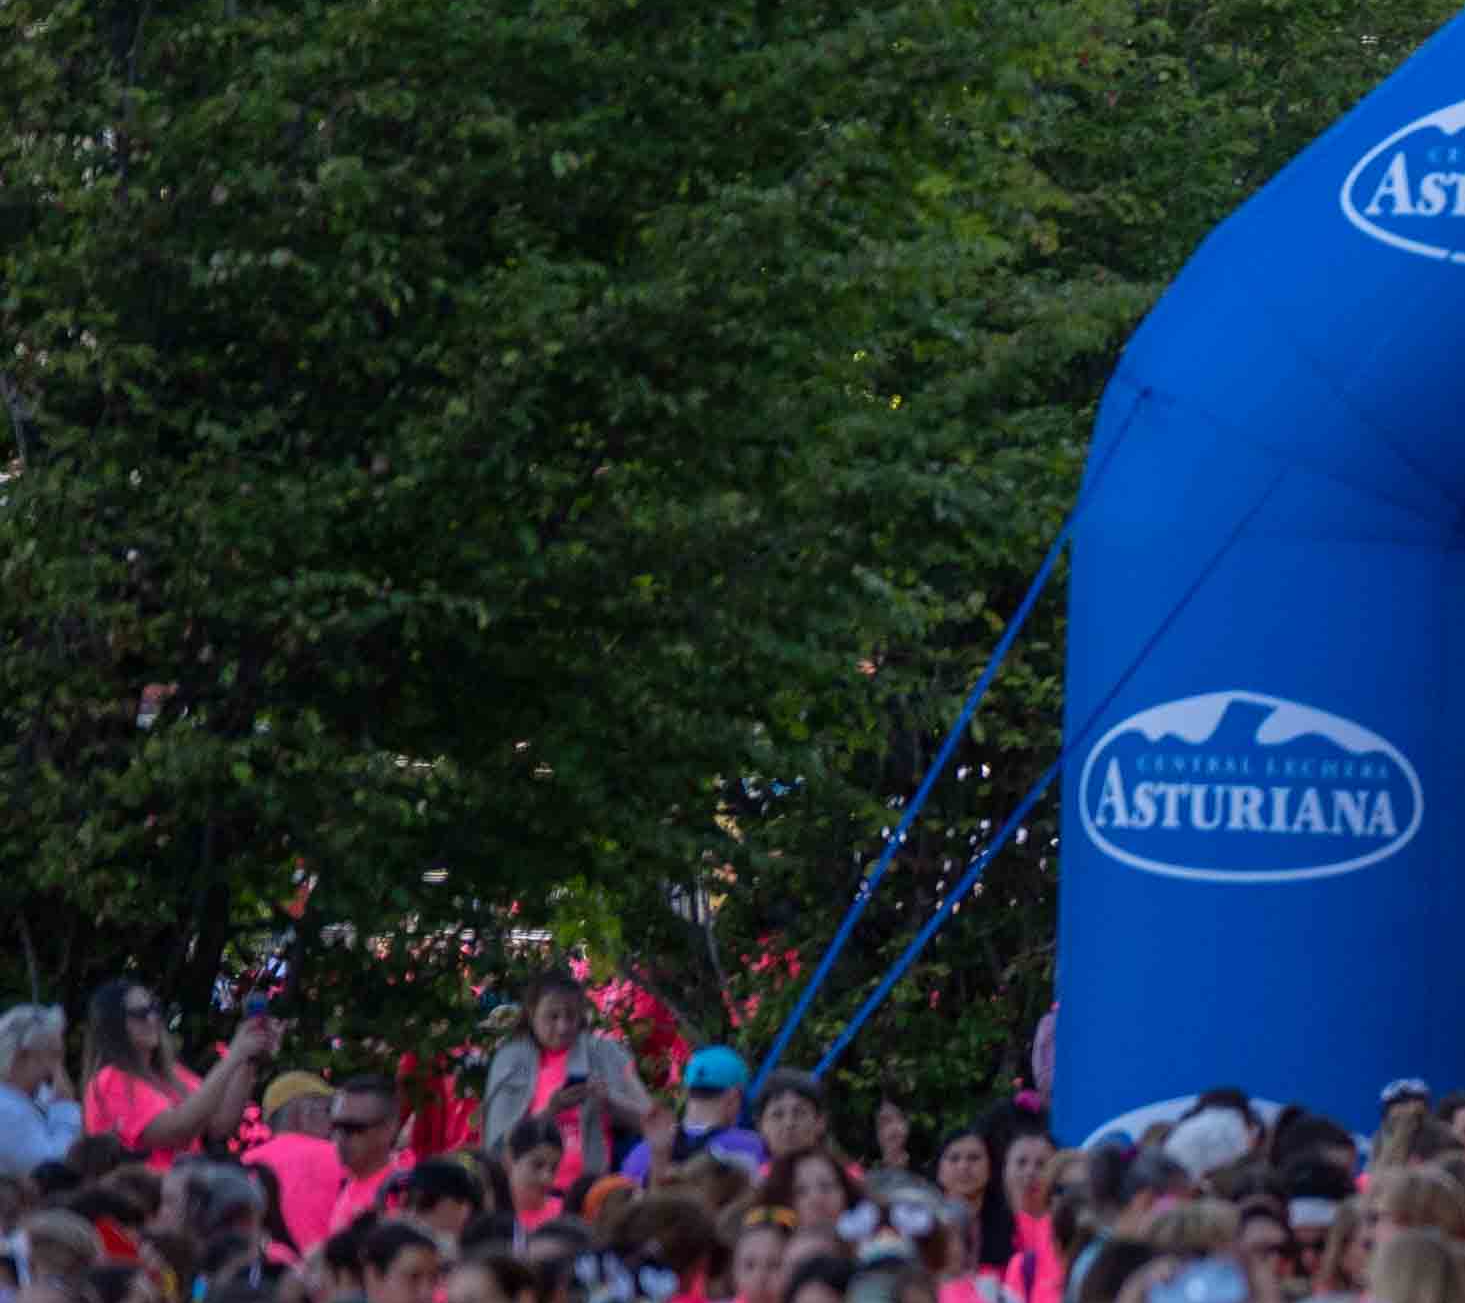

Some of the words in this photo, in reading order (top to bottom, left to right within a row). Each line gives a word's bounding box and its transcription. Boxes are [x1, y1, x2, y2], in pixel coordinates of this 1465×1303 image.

[1137, 754, 1251, 776] CENTRAL
[1265, 757, 1391, 780] LECHERA
[1096, 757, 1399, 838] ASTURIANA
